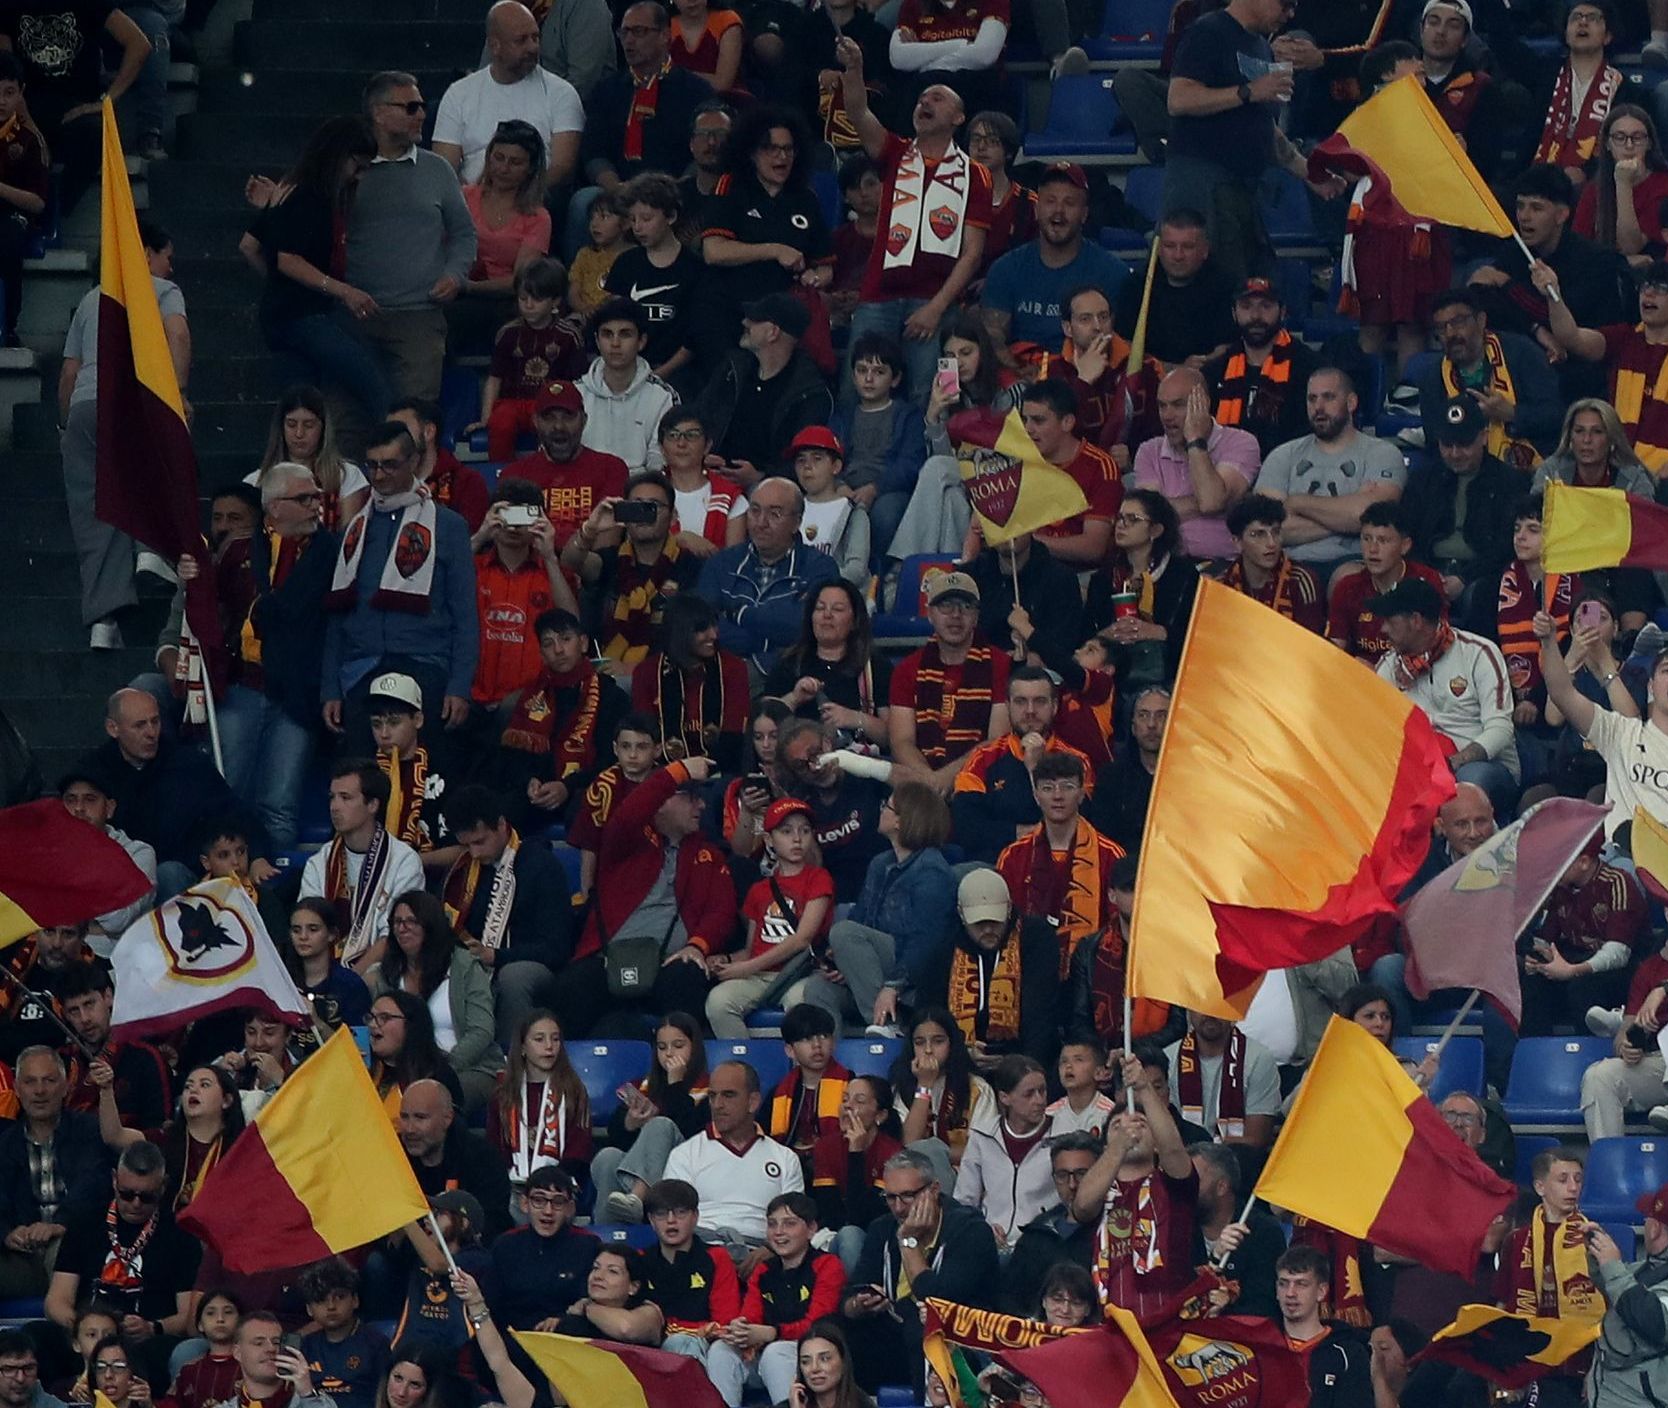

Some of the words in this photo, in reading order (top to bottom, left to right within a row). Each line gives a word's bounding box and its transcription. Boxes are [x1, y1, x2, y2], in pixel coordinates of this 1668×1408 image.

[970, 475, 1017, 502] ROMA
[1358, 638, 1394, 653] digita
[1195, 1373, 1257, 1406] ROMA
